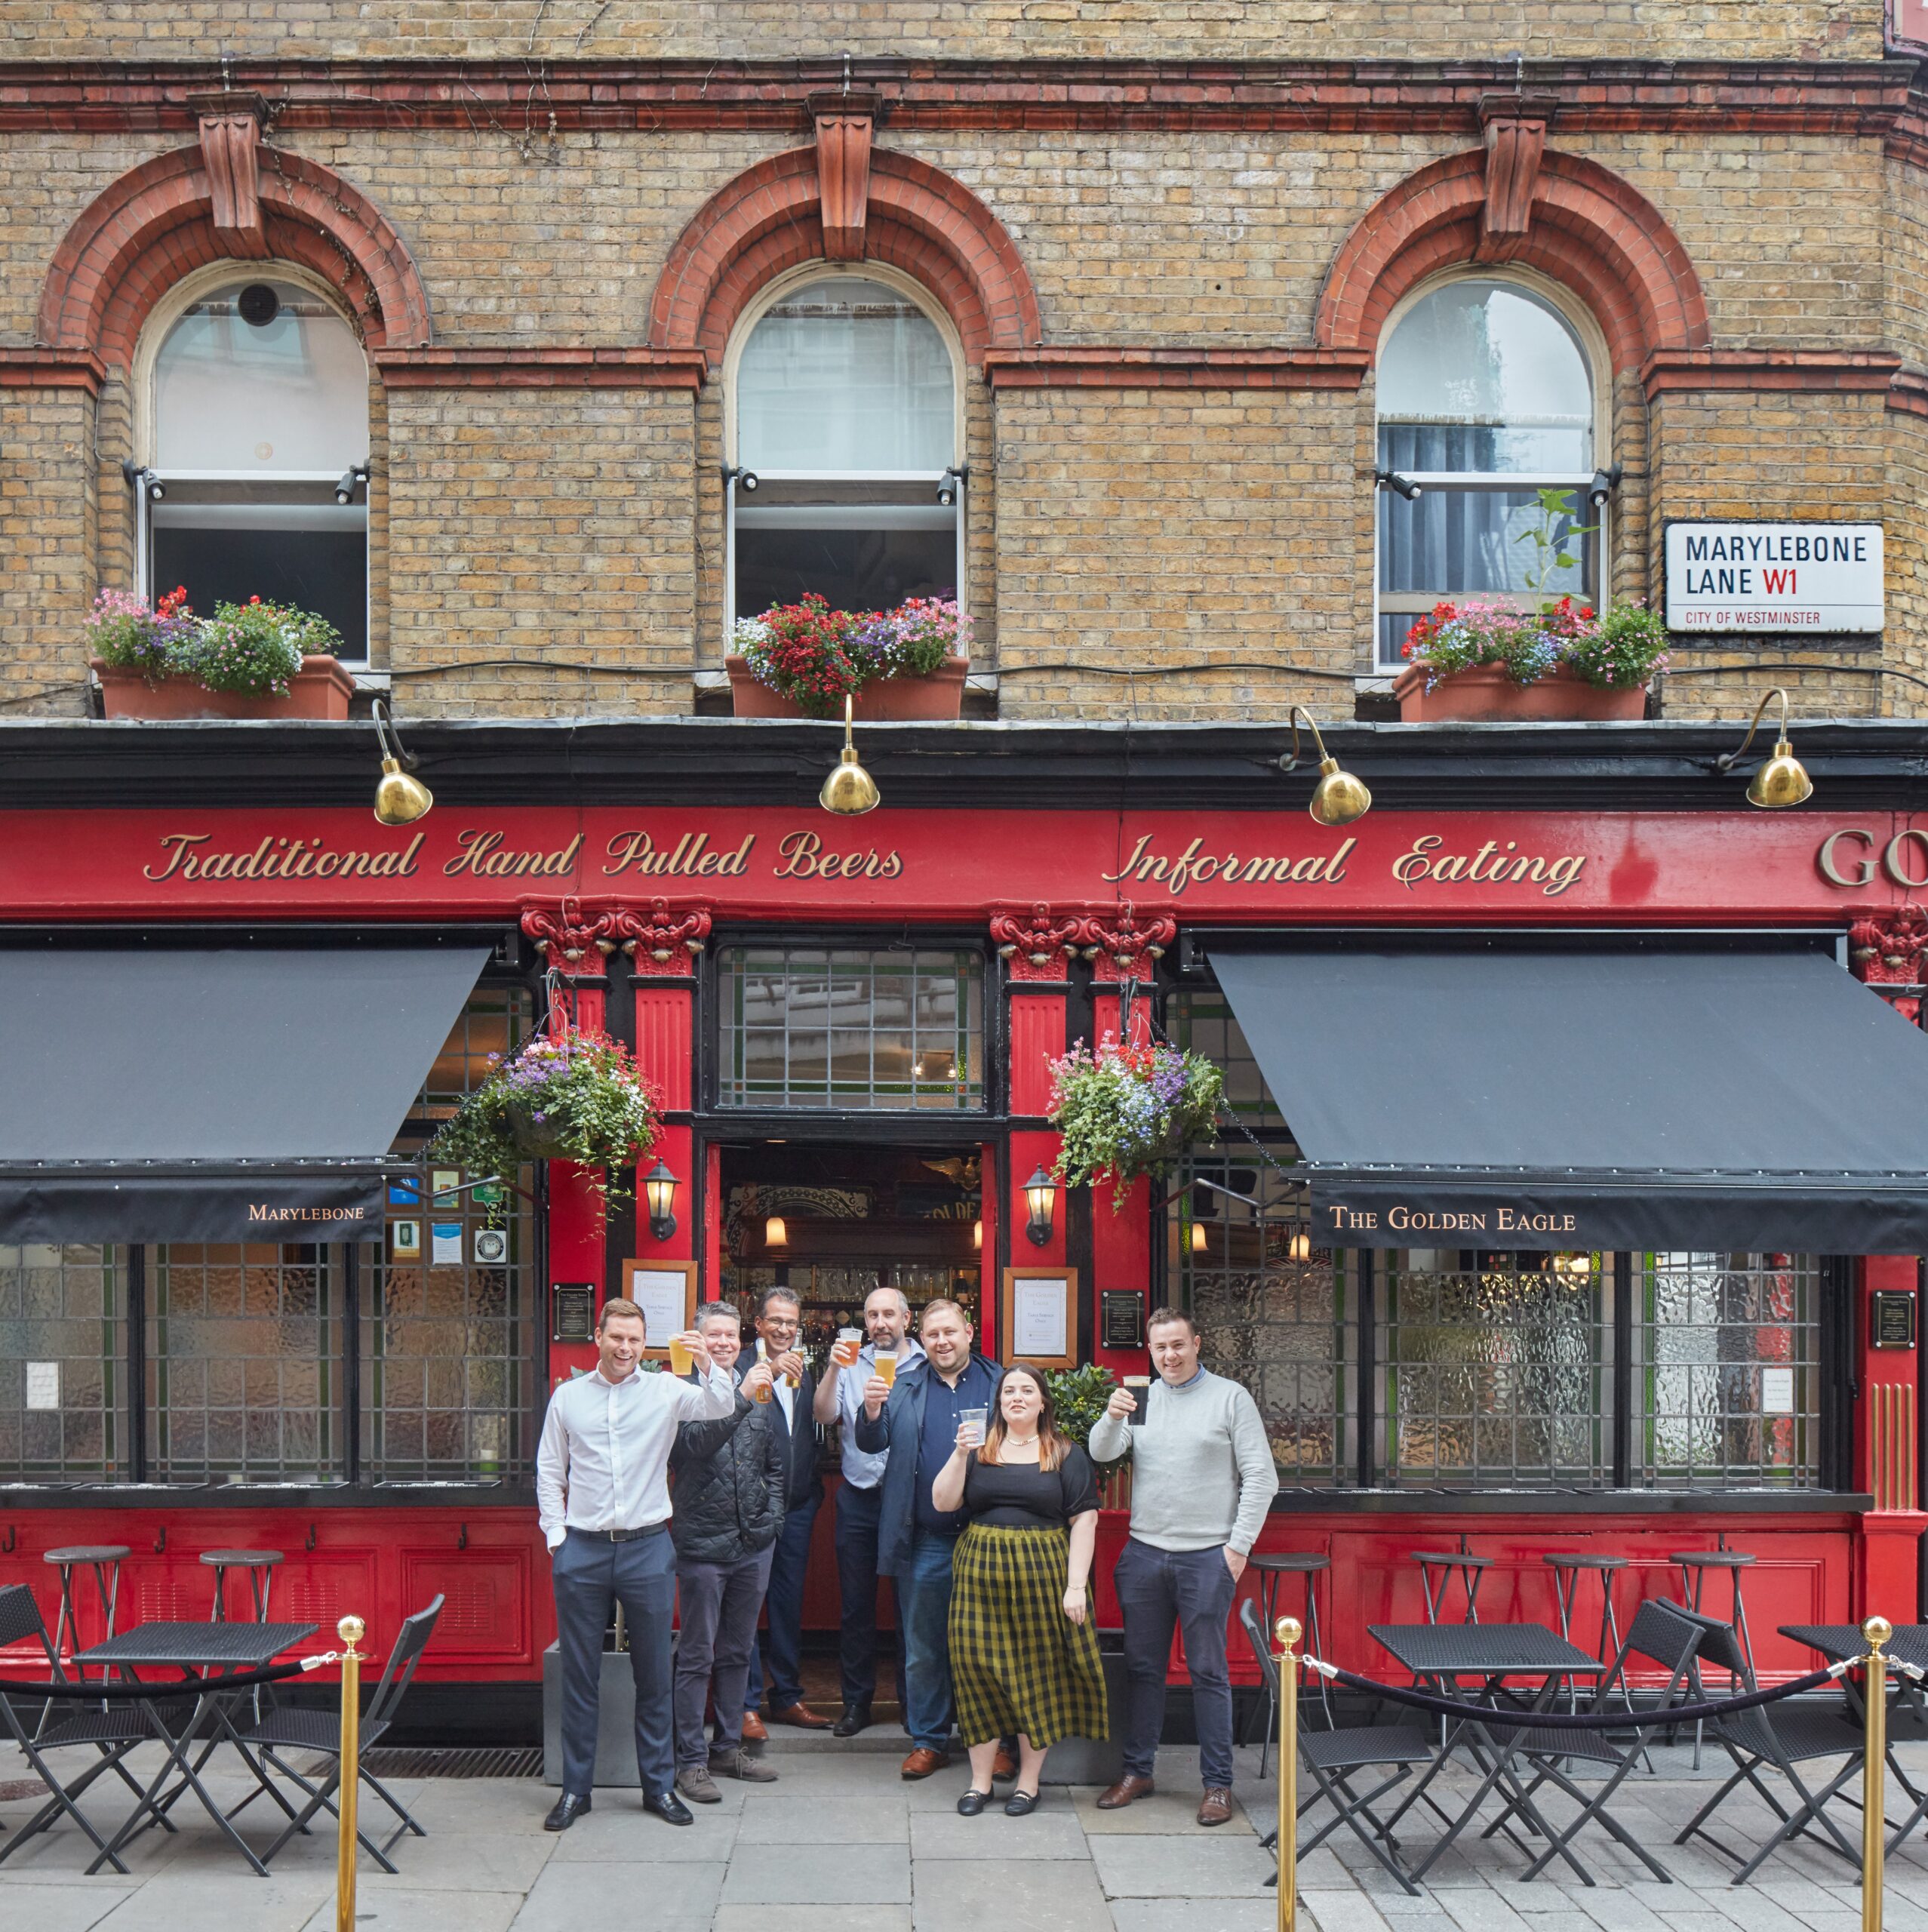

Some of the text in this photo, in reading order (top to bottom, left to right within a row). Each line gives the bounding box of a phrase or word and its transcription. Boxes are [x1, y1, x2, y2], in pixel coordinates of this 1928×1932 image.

[1686, 536, 1867, 561] MARYLEBONE
[1686, 568, 1797, 594] LANE W1
[1686, 611, 1820, 624] CITY OF WESTMINSTER
[143, 829, 904, 881] Traditional Hand Pulled Beers
[1101, 833, 1586, 897] Informal Eating
[248, 1204, 364, 1221] MARYLEBONE
[1329, 1206, 1576, 1232] THE GOLDEN EAGLE
